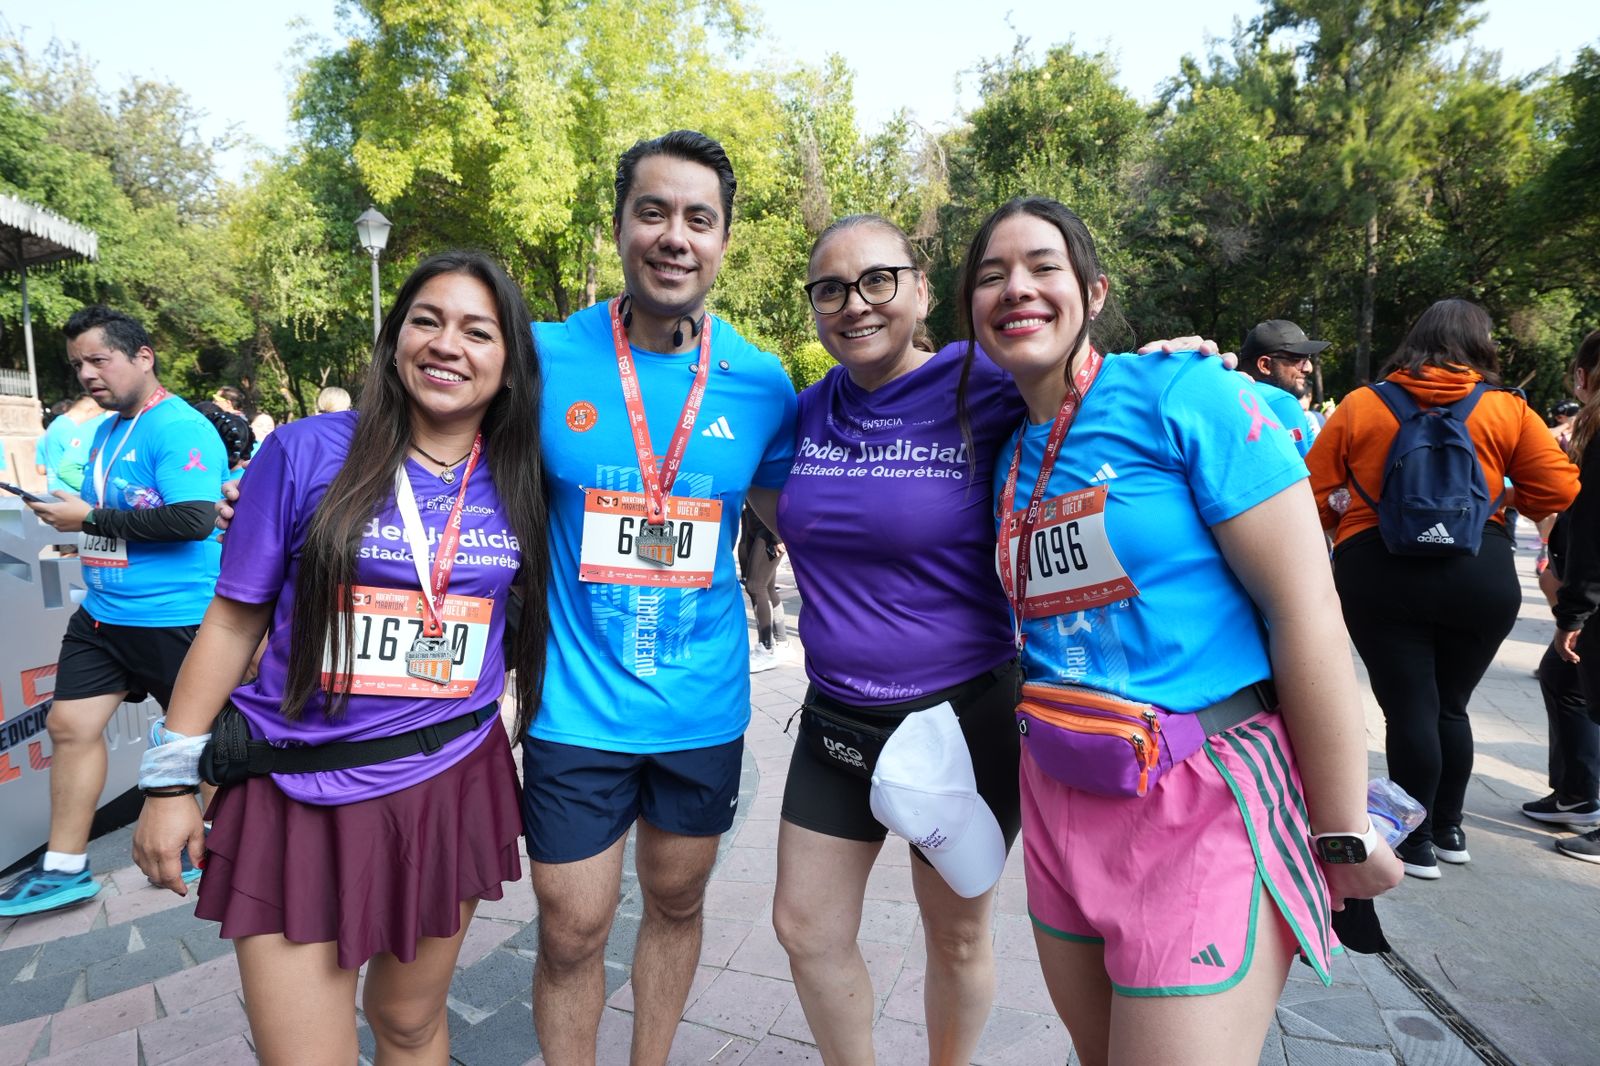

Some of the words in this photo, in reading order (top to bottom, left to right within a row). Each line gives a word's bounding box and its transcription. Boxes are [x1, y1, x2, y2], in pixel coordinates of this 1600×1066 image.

[798, 437, 851, 463] Poder
[856, 438, 967, 464] Judicial
[801, 463, 844, 476] Estado
[847, 467, 868, 477] de
[871, 465, 963, 480] Querétaro
[1416, 535, 1455, 544] adidas
